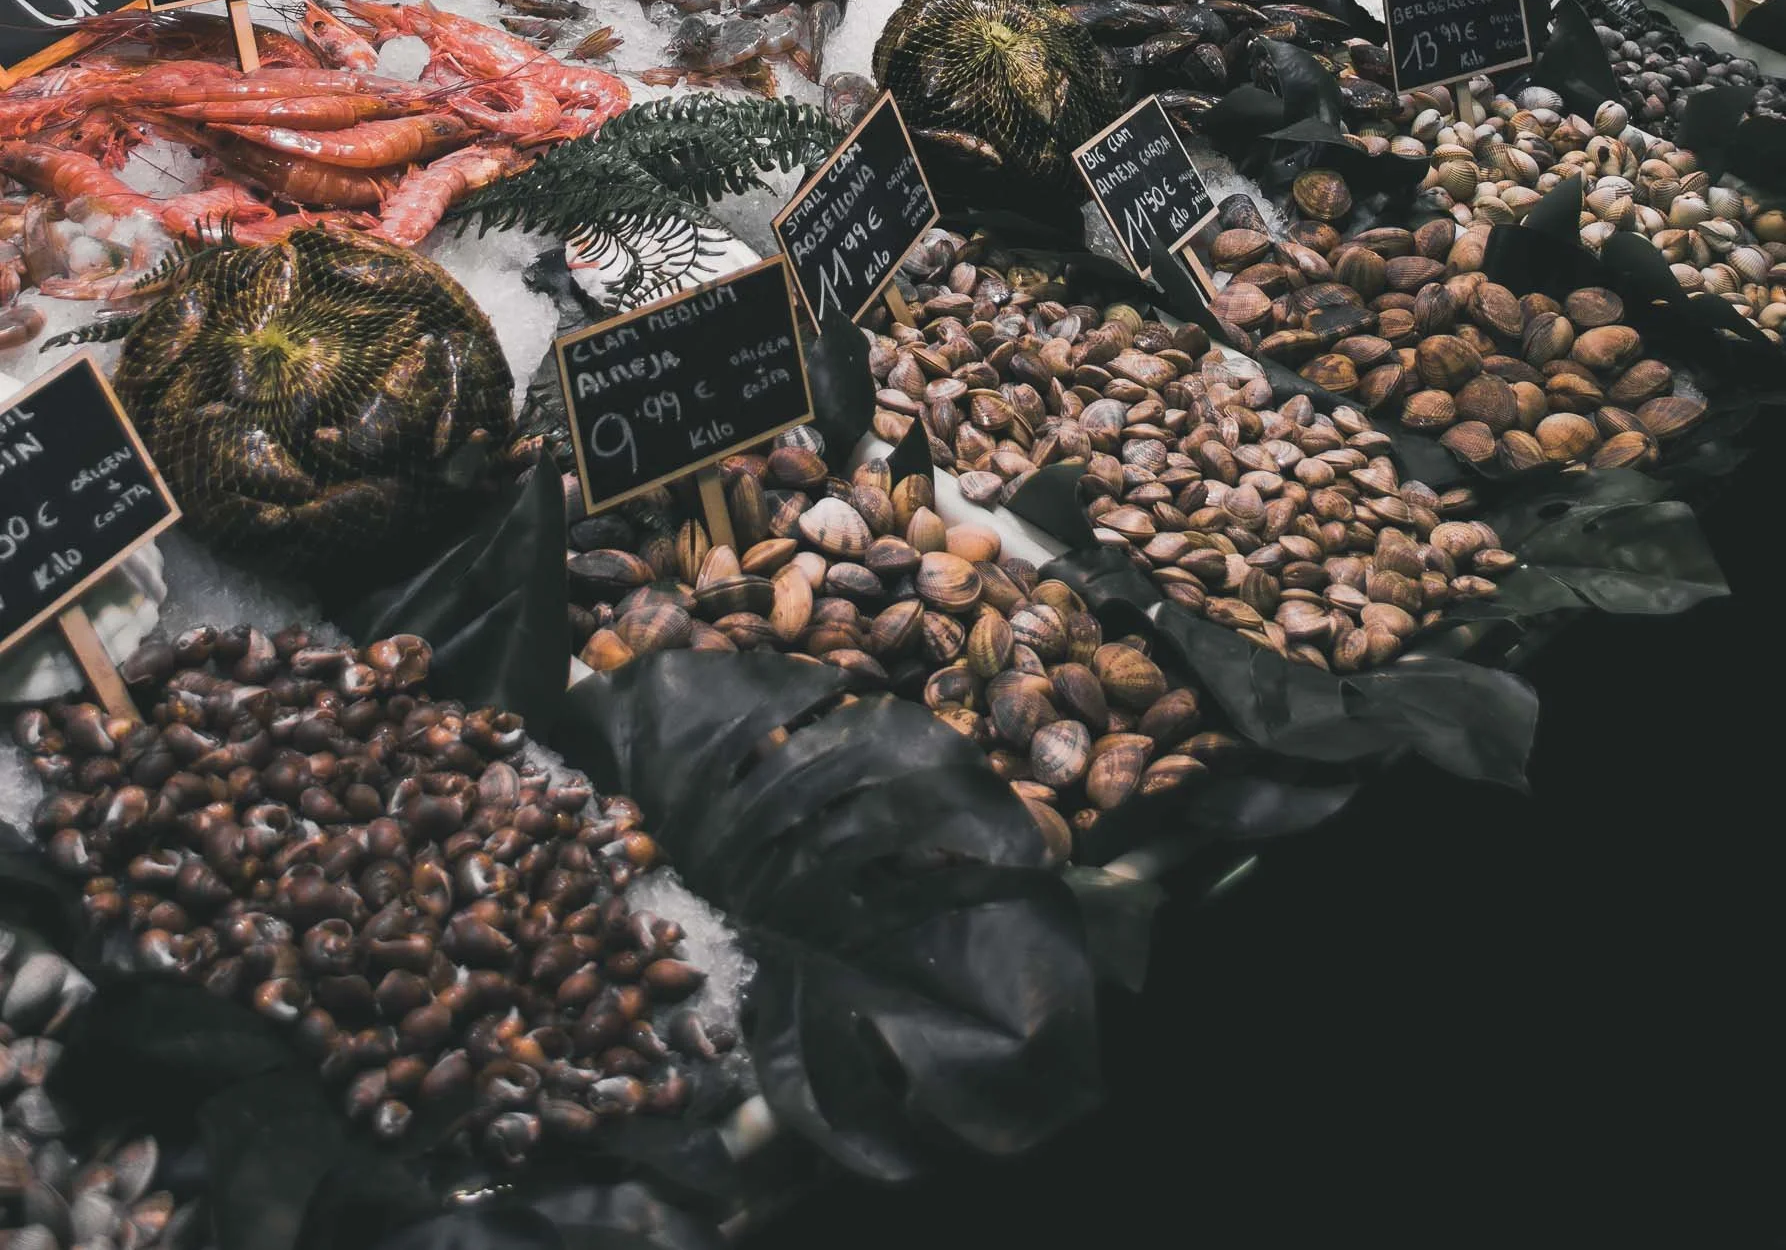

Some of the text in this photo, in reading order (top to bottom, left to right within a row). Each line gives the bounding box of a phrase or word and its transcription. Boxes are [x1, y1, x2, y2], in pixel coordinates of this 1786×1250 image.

[1082, 126, 1135, 171] BIG CLAM
[1095, 134, 1173, 197] ALMEJA GORDA
[785, 141, 864, 237] SMALL CLAM
[573, 284, 738, 363] CLAM MEDIUM
[577, 350, 681, 401] ALMEJA
